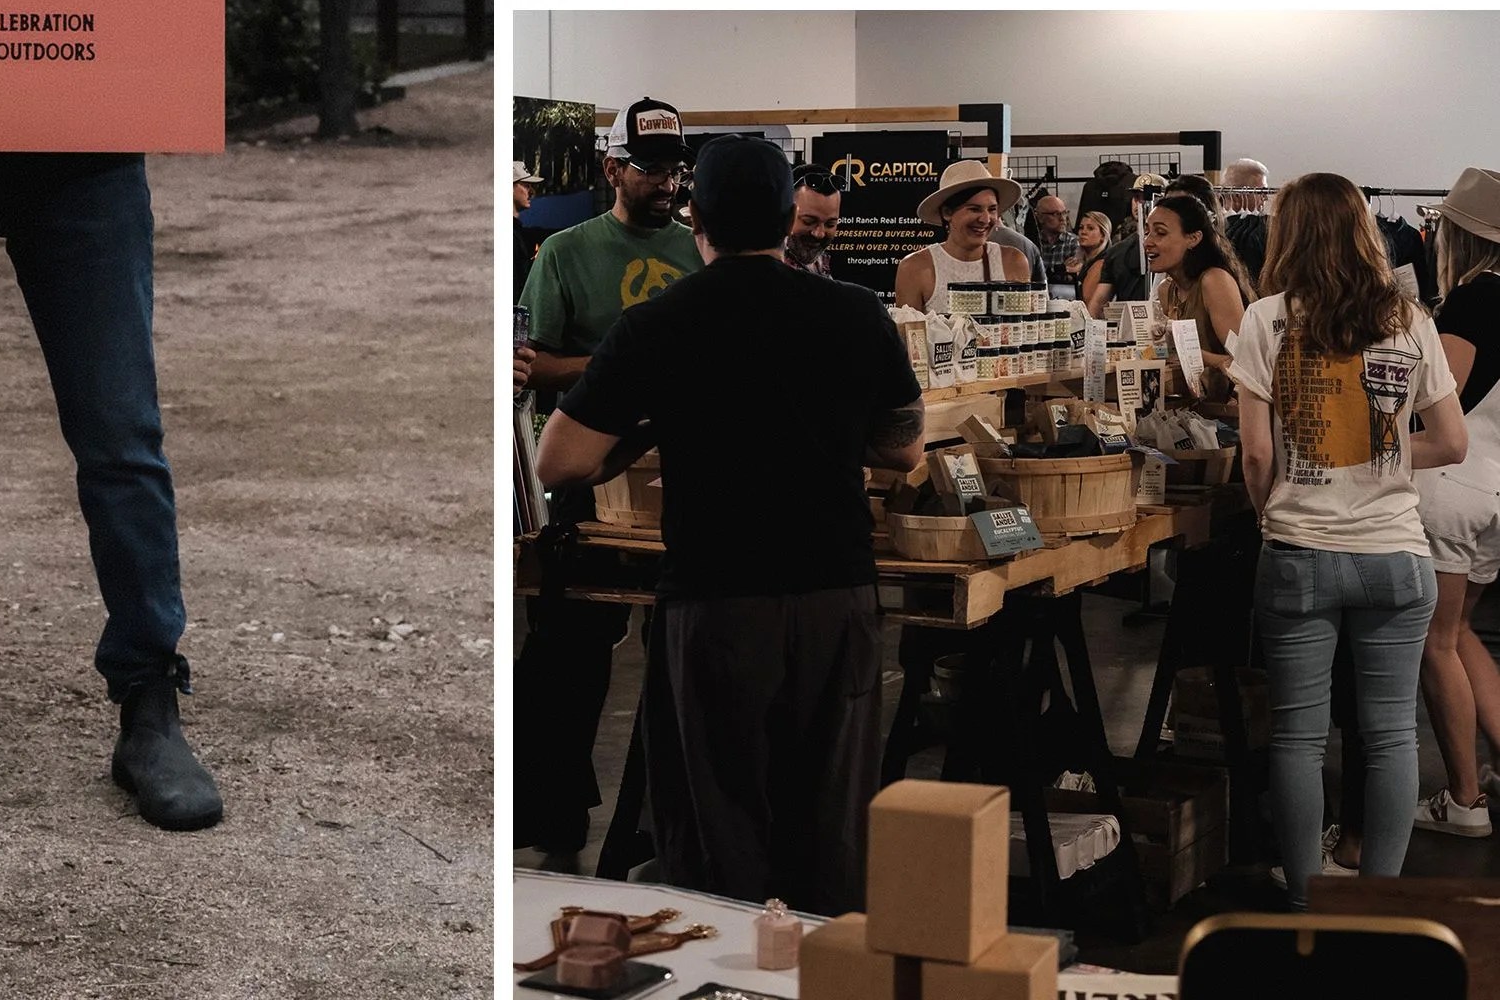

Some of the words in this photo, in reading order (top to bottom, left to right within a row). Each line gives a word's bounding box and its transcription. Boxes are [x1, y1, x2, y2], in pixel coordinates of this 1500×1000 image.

[869, 162, 938, 176] CAPITOL
[836, 217, 854, 226] pitol
[834, 230, 883, 238] EPRESENTED
[885, 230, 915, 238] BUYERS
[917, 230, 934, 238] AND
[827, 243, 854, 251] ELLERS
[855, 243, 863, 251] IN
[864, 243, 889, 251] OVER
[889, 243, 900, 251] 70
[847, 257, 888, 265] throughout
[992, 511, 1012, 521] SALLYE
[995, 518, 1016, 527] ANDER
[994, 526, 1024, 535] EUCALYPTUS
